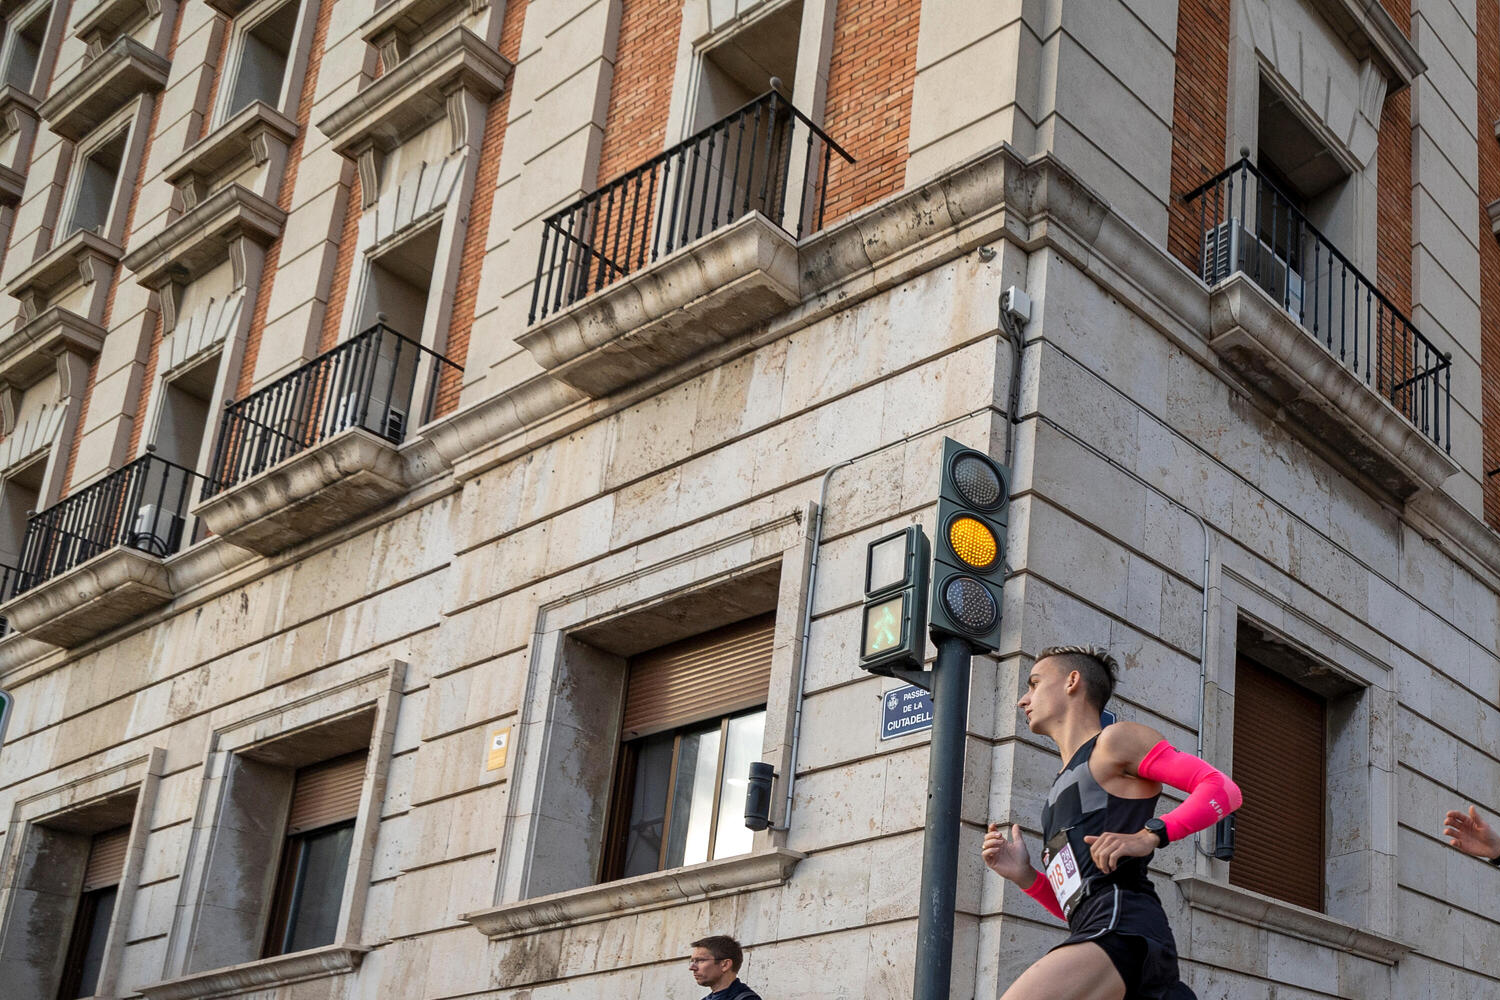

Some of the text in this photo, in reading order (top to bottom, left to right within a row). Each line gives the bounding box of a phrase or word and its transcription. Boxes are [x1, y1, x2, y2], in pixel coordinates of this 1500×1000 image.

[903, 702, 923, 713] DE LA
[887, 712, 933, 731] CIUTADELL
